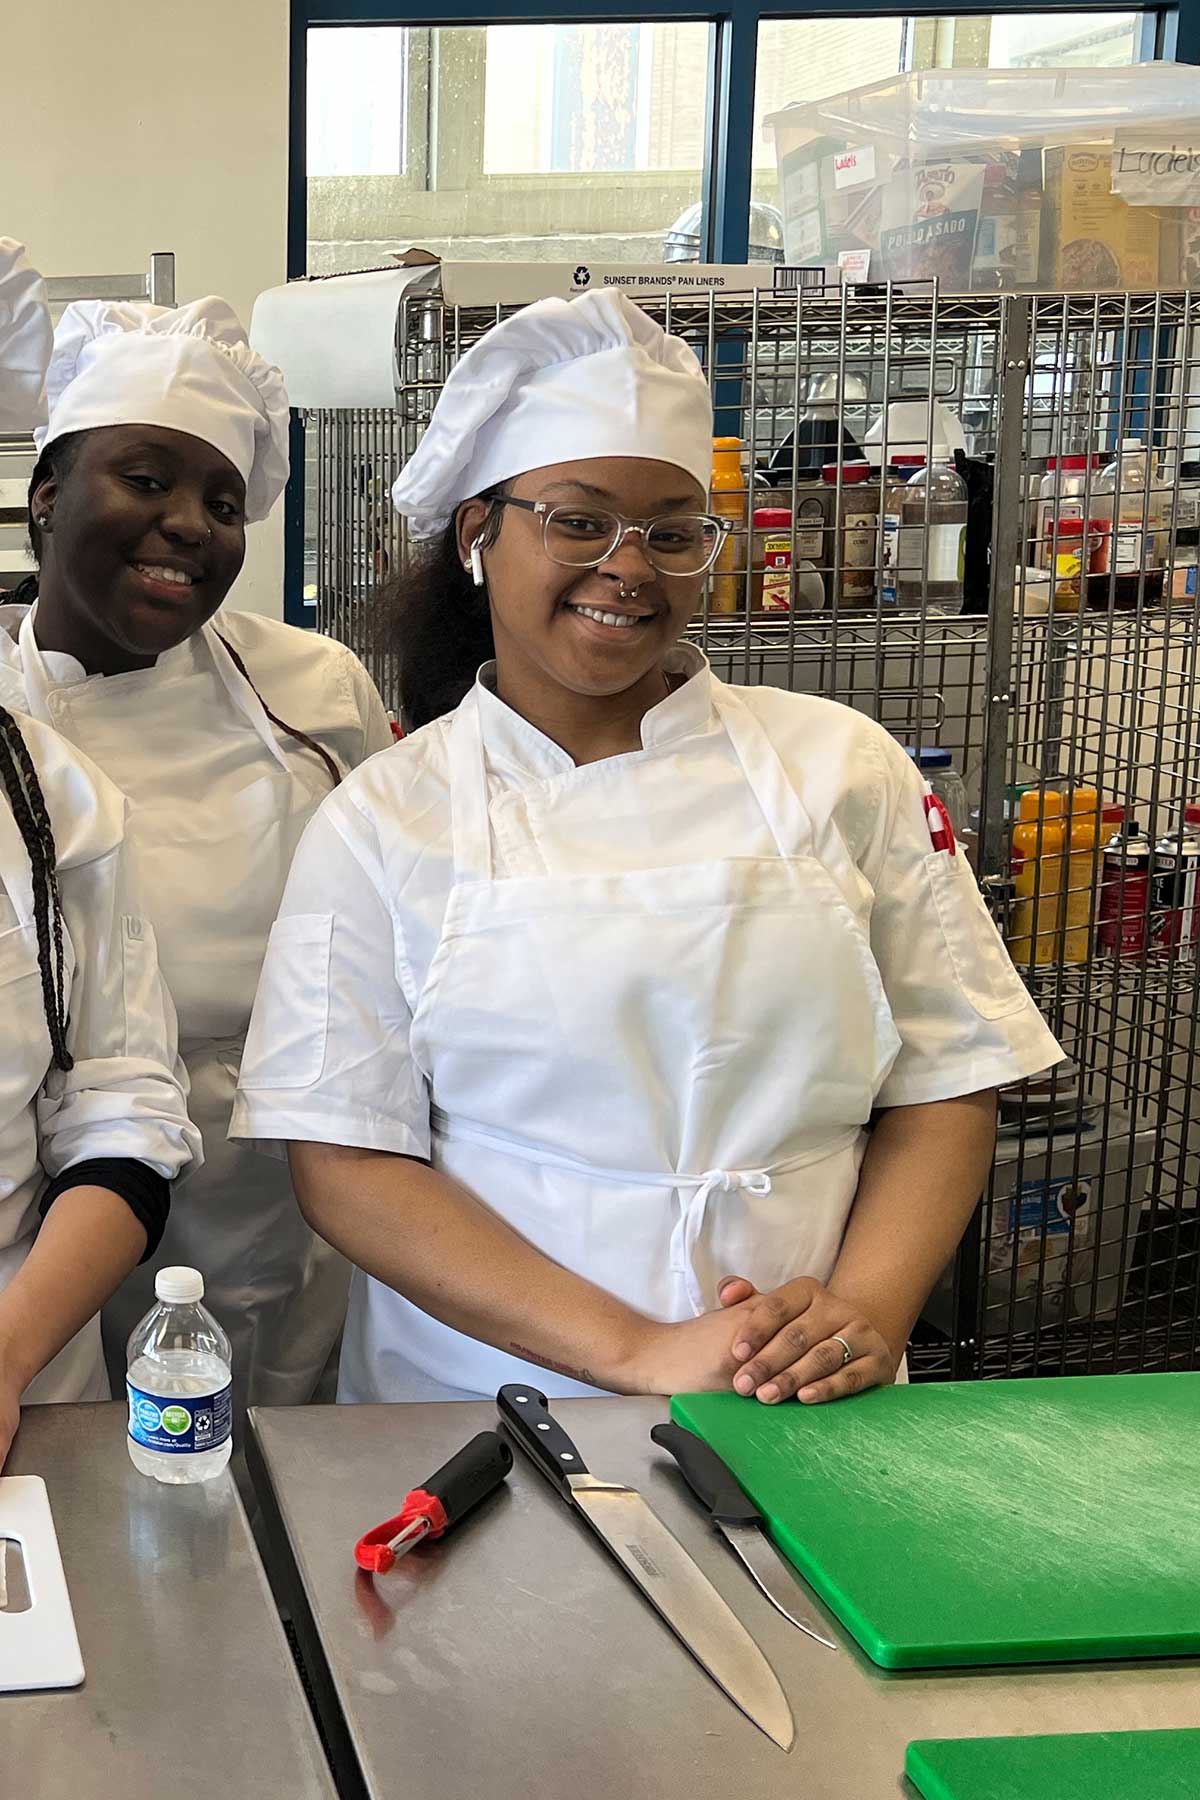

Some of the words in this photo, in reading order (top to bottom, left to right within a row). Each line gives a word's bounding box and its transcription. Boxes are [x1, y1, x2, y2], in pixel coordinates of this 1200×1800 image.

[925, 218, 966, 242] ASADO
[603, 276, 636, 285] SUNSET
[677, 277, 694, 286] PAN
[696, 277, 725, 286] LINERS
